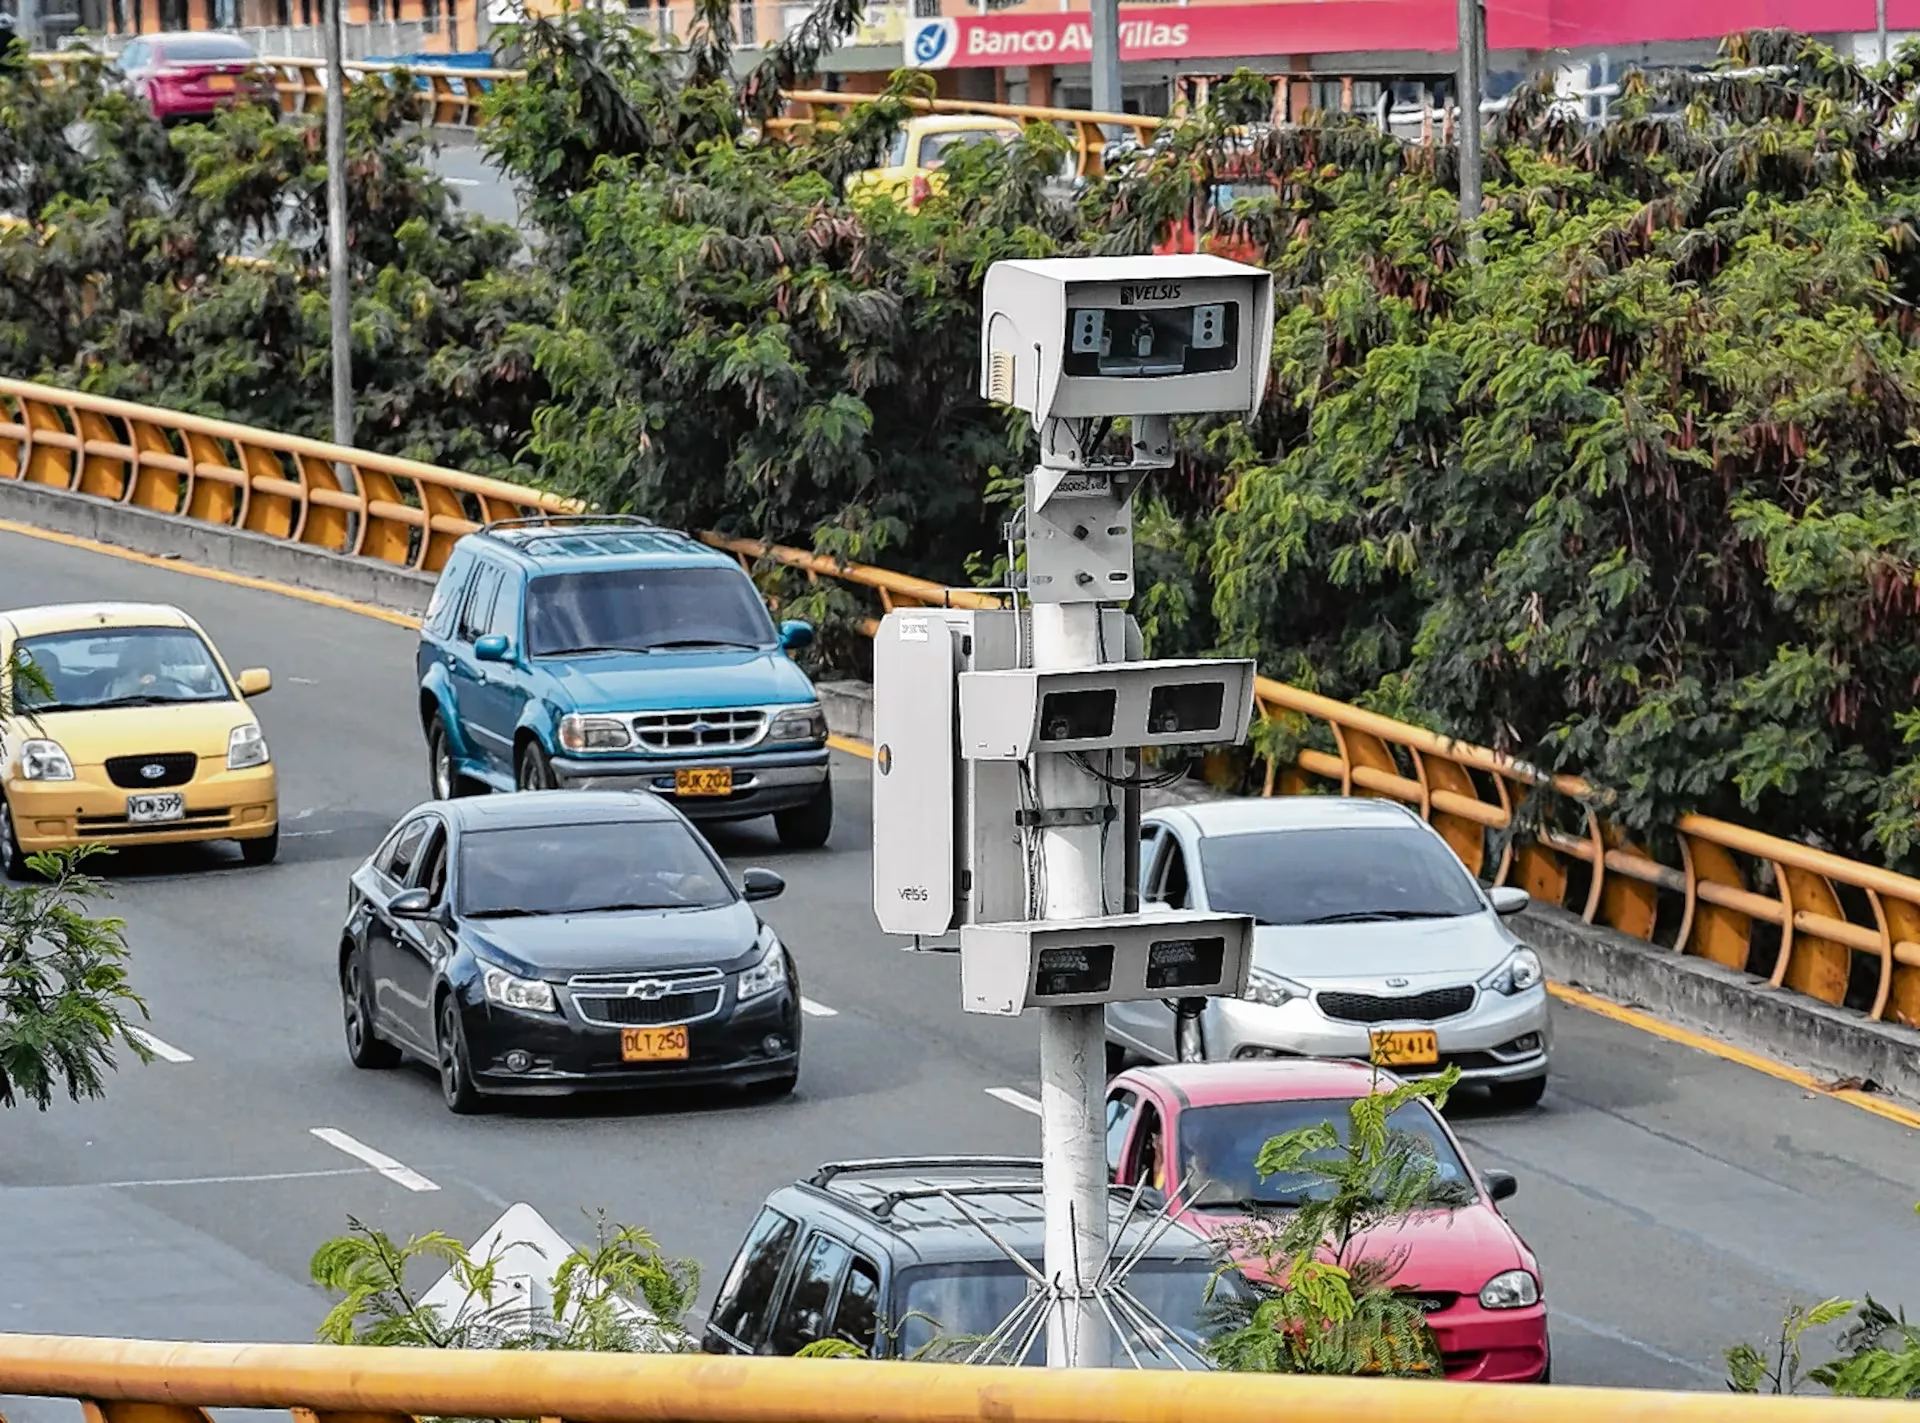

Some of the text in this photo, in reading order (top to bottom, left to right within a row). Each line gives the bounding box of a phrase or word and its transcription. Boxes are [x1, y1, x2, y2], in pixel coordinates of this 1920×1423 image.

[968, 27, 1054, 55] Banco
[1135, 284, 1182, 300] VELSIS
[706, 773, 730, 787] 202
[157, 796, 182, 812] 399
[624, 1031, 686, 1052] DLT 250
[1407, 1036, 1435, 1054] 414
